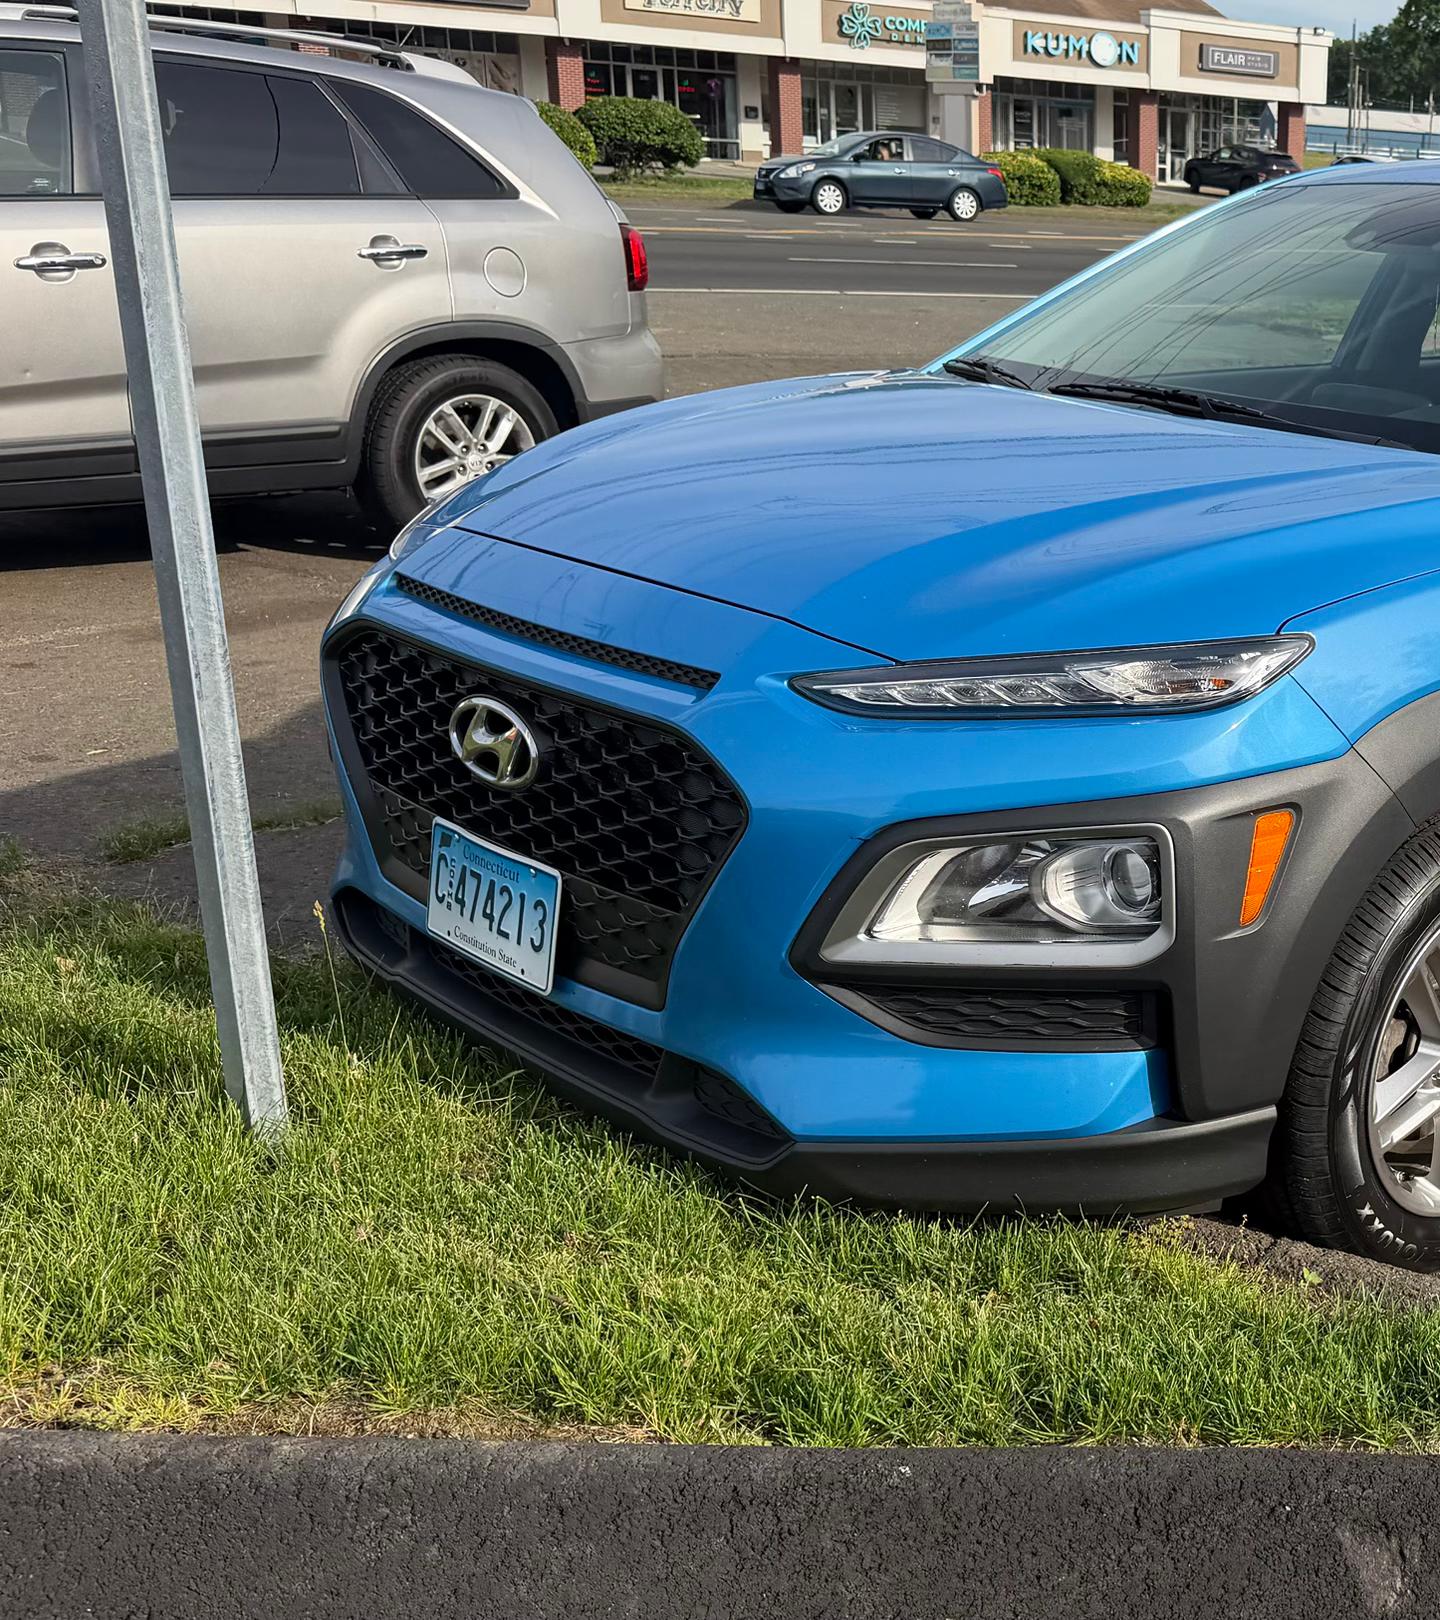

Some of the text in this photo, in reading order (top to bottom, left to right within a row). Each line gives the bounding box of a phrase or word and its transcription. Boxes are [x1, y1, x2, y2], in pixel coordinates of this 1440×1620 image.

[1024, 30, 1141, 66] KUMON
[1214, 52, 1246, 66] FLAIR
[462, 845, 520, 884] Connecticut
[453, 924, 517, 968] Constitution State
